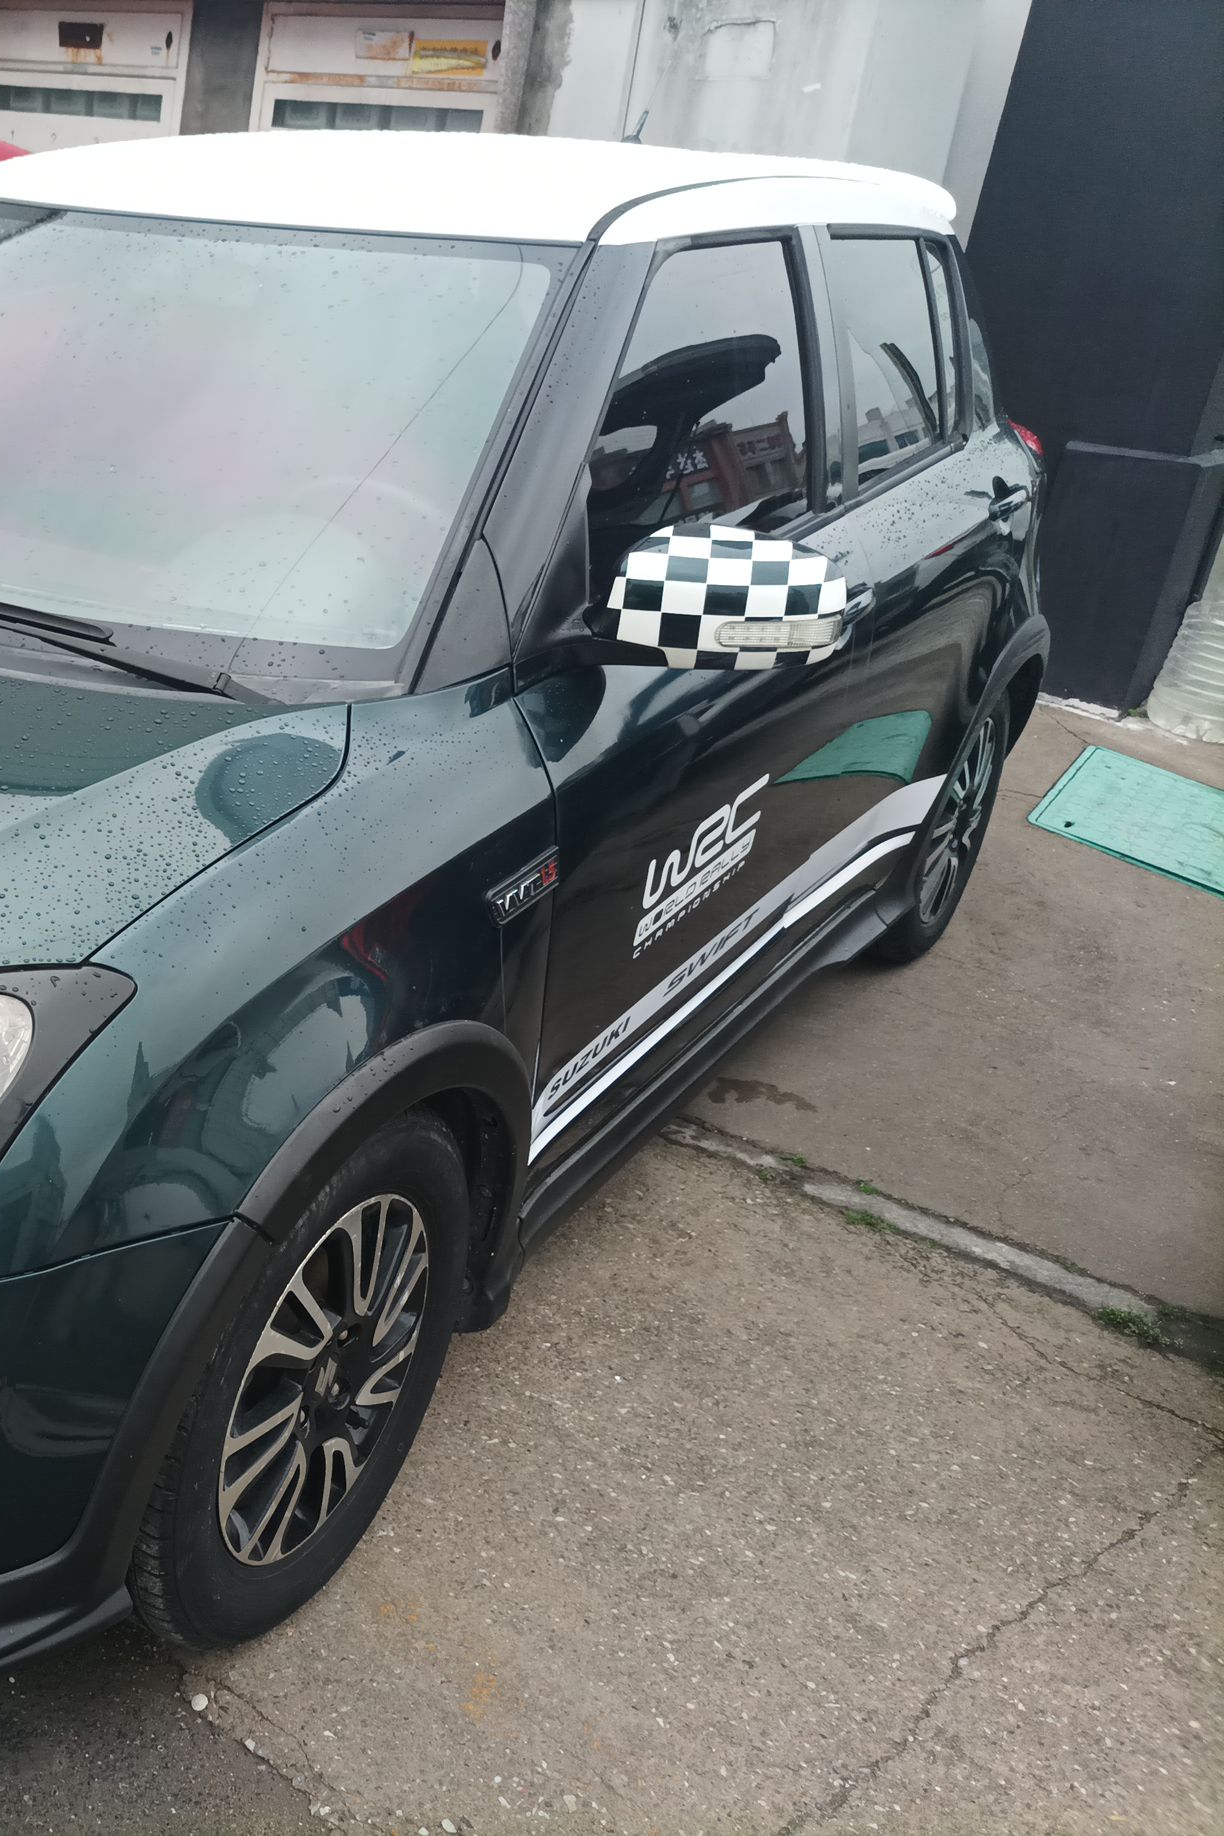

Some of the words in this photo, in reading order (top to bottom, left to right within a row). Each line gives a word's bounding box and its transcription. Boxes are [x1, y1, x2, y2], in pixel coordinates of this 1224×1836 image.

[632, 860, 746, 960] CHAMPIONSHIP
[547, 1015, 631, 1100] SUZUKI
[663, 906, 760, 998] SWIFT
